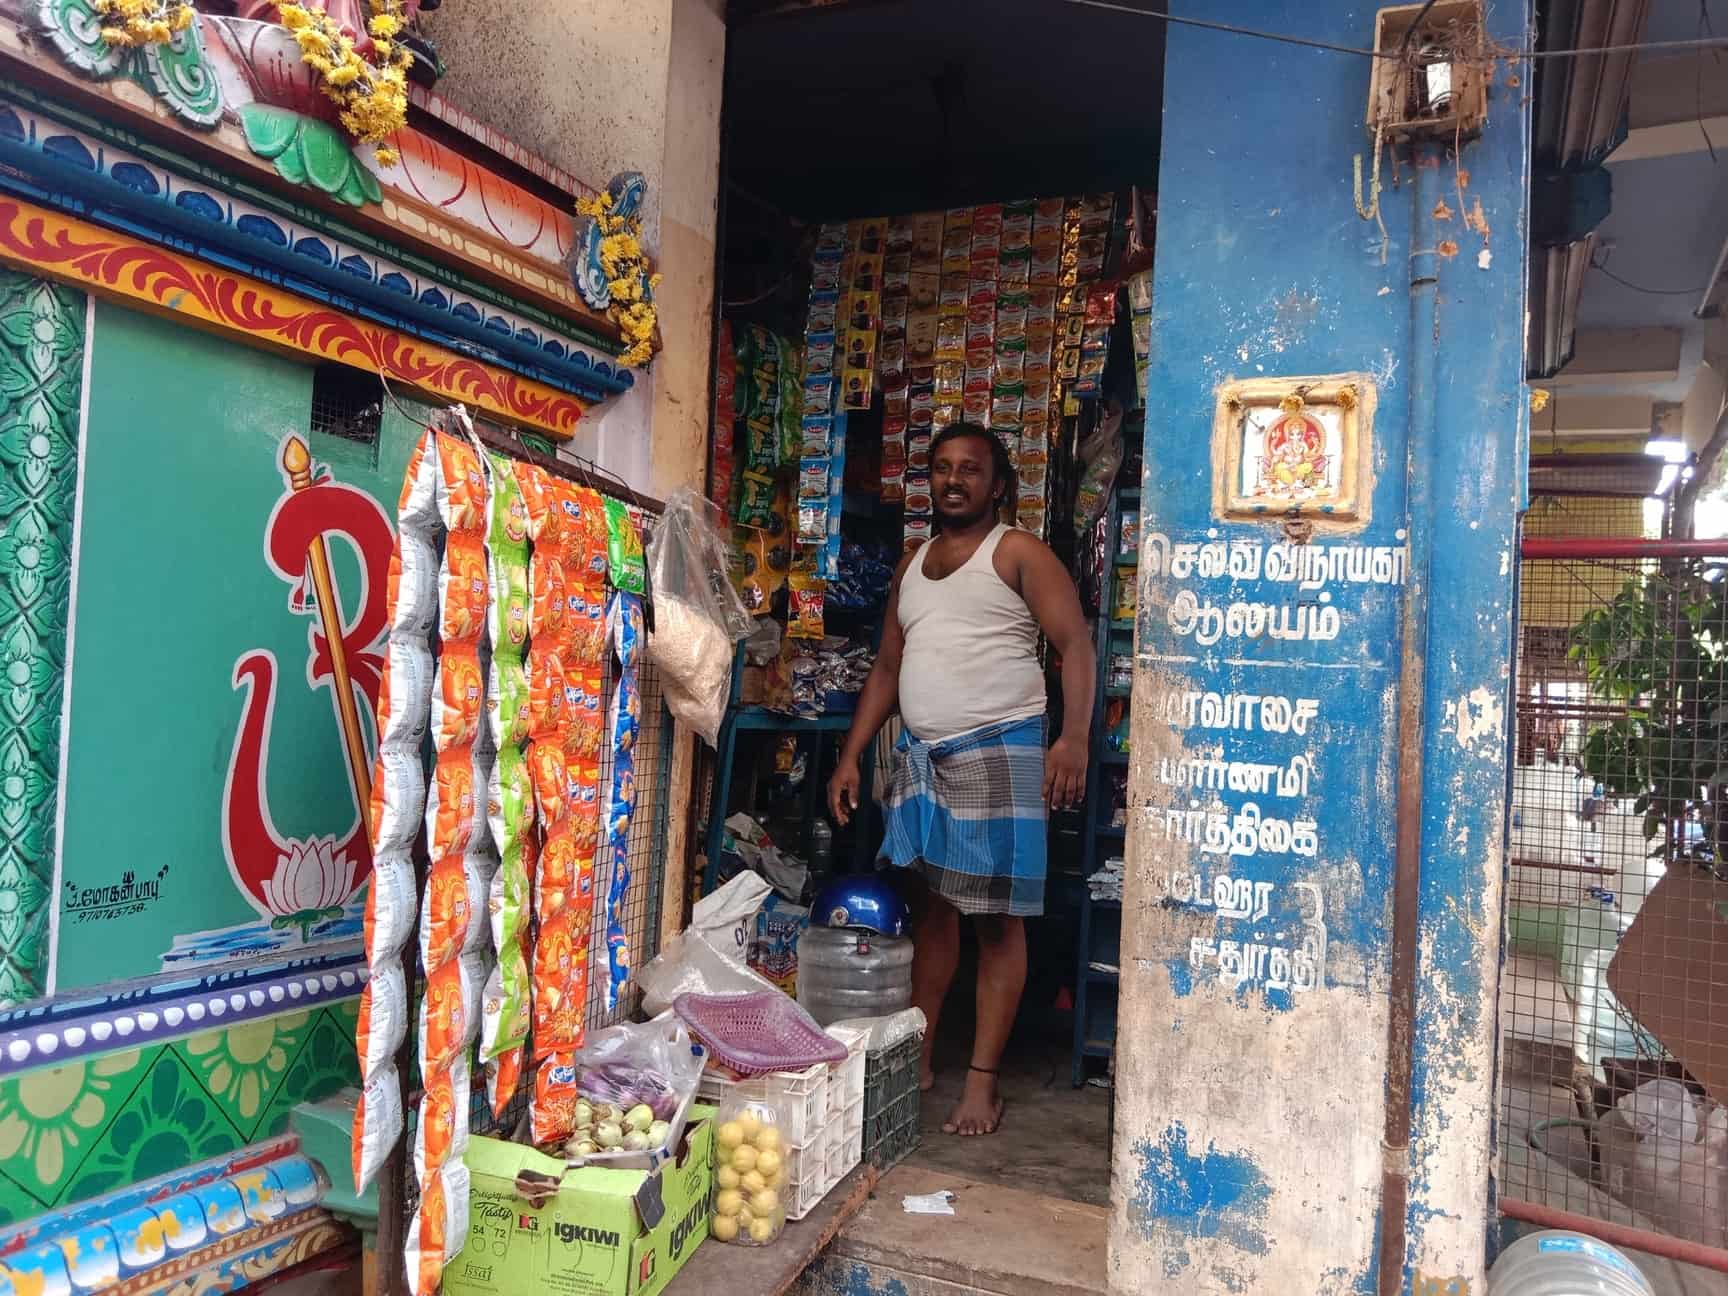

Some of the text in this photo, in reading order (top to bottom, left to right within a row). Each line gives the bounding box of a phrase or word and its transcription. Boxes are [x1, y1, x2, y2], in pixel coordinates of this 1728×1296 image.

[1167, 590, 1341, 645] ஆலயம்
[472, 1225, 485, 1235] 54
[494, 1228, 506, 1239] 72
